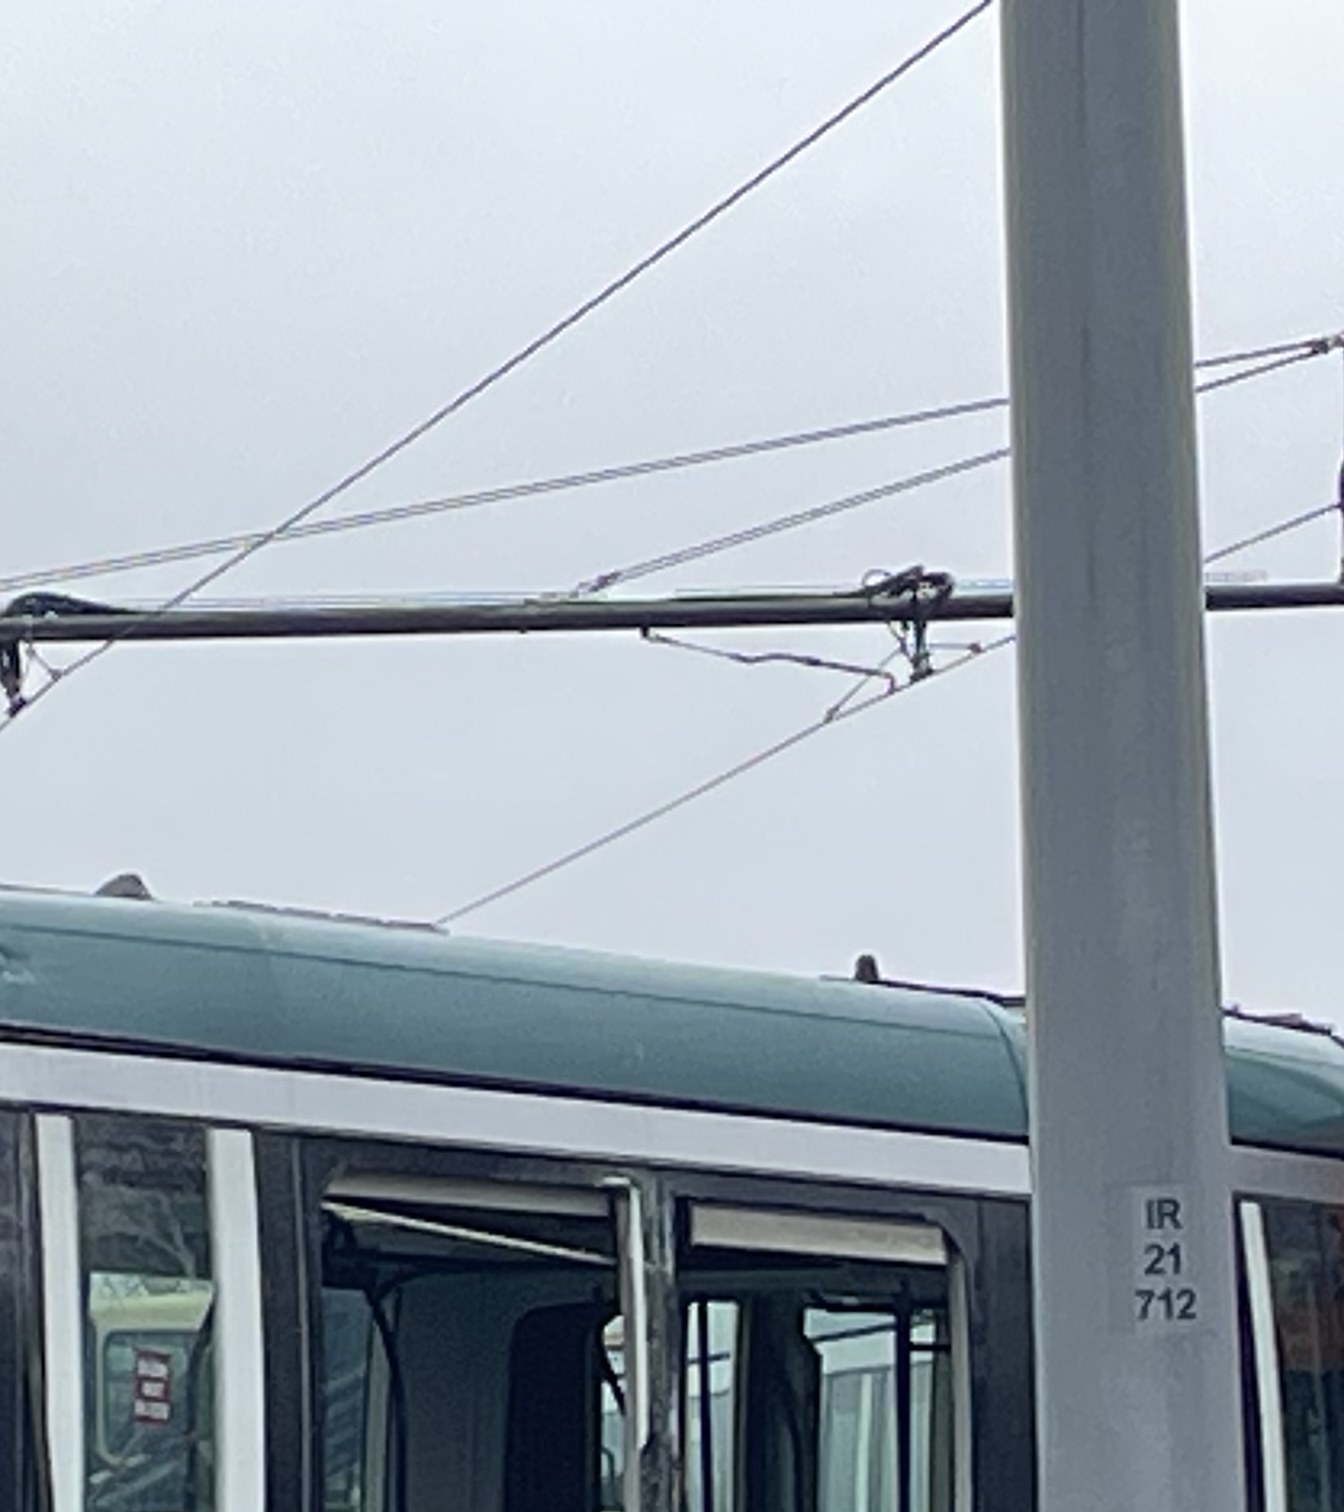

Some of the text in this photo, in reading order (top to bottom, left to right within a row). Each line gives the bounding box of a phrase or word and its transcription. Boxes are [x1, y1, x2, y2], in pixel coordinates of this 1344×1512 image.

[1145, 1198, 1184, 1230] IR
[1143, 1242, 1181, 1275] 21
[1134, 1286, 1197, 1320] 712
